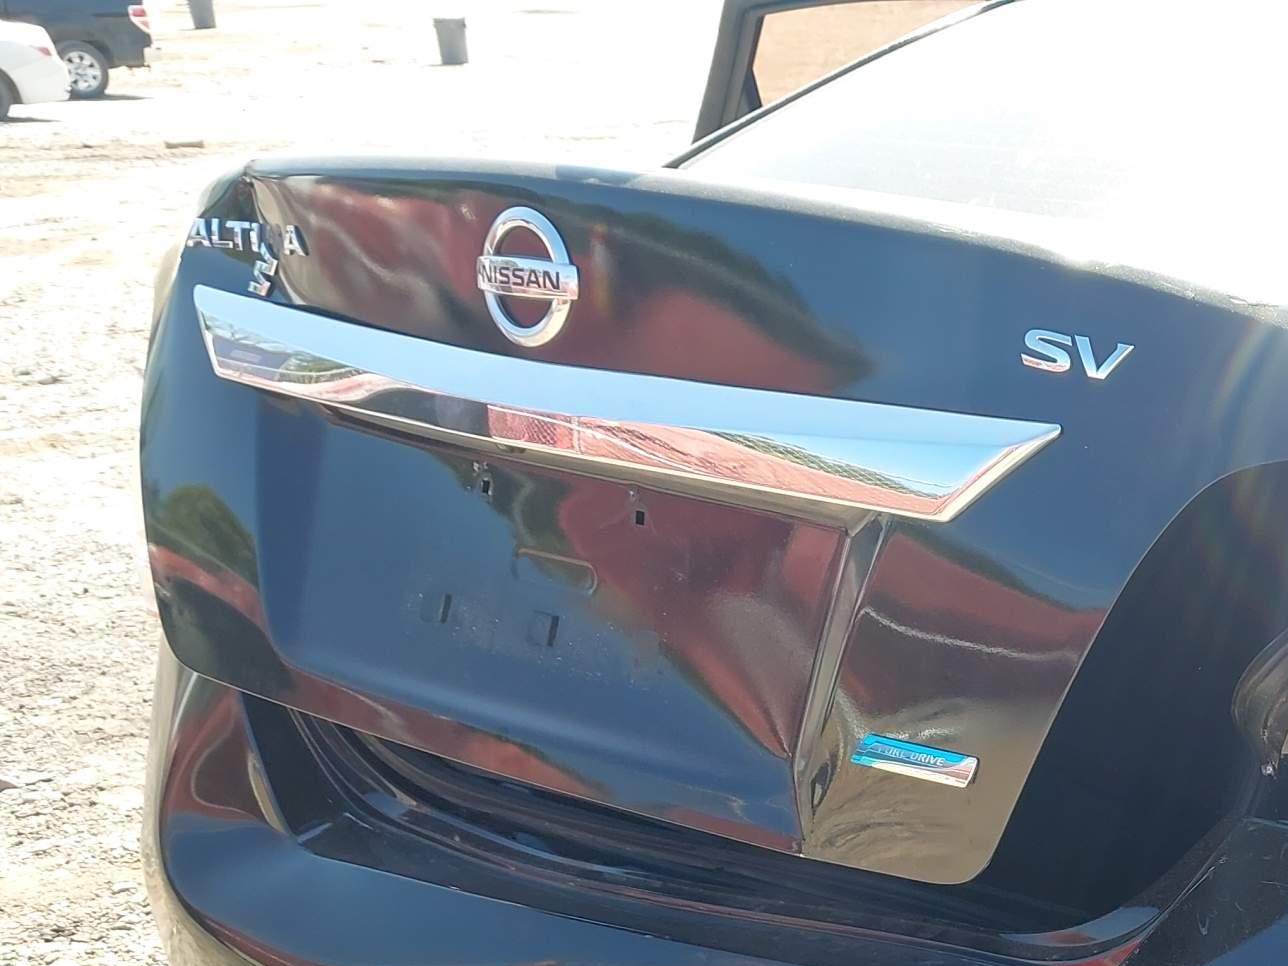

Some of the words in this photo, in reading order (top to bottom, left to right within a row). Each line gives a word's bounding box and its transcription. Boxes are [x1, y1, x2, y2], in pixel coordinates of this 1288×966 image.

[480, 263, 560, 290] NISSAN
[1021, 329, 1135, 380] SV
[910, 752, 945, 767] DRIVE
